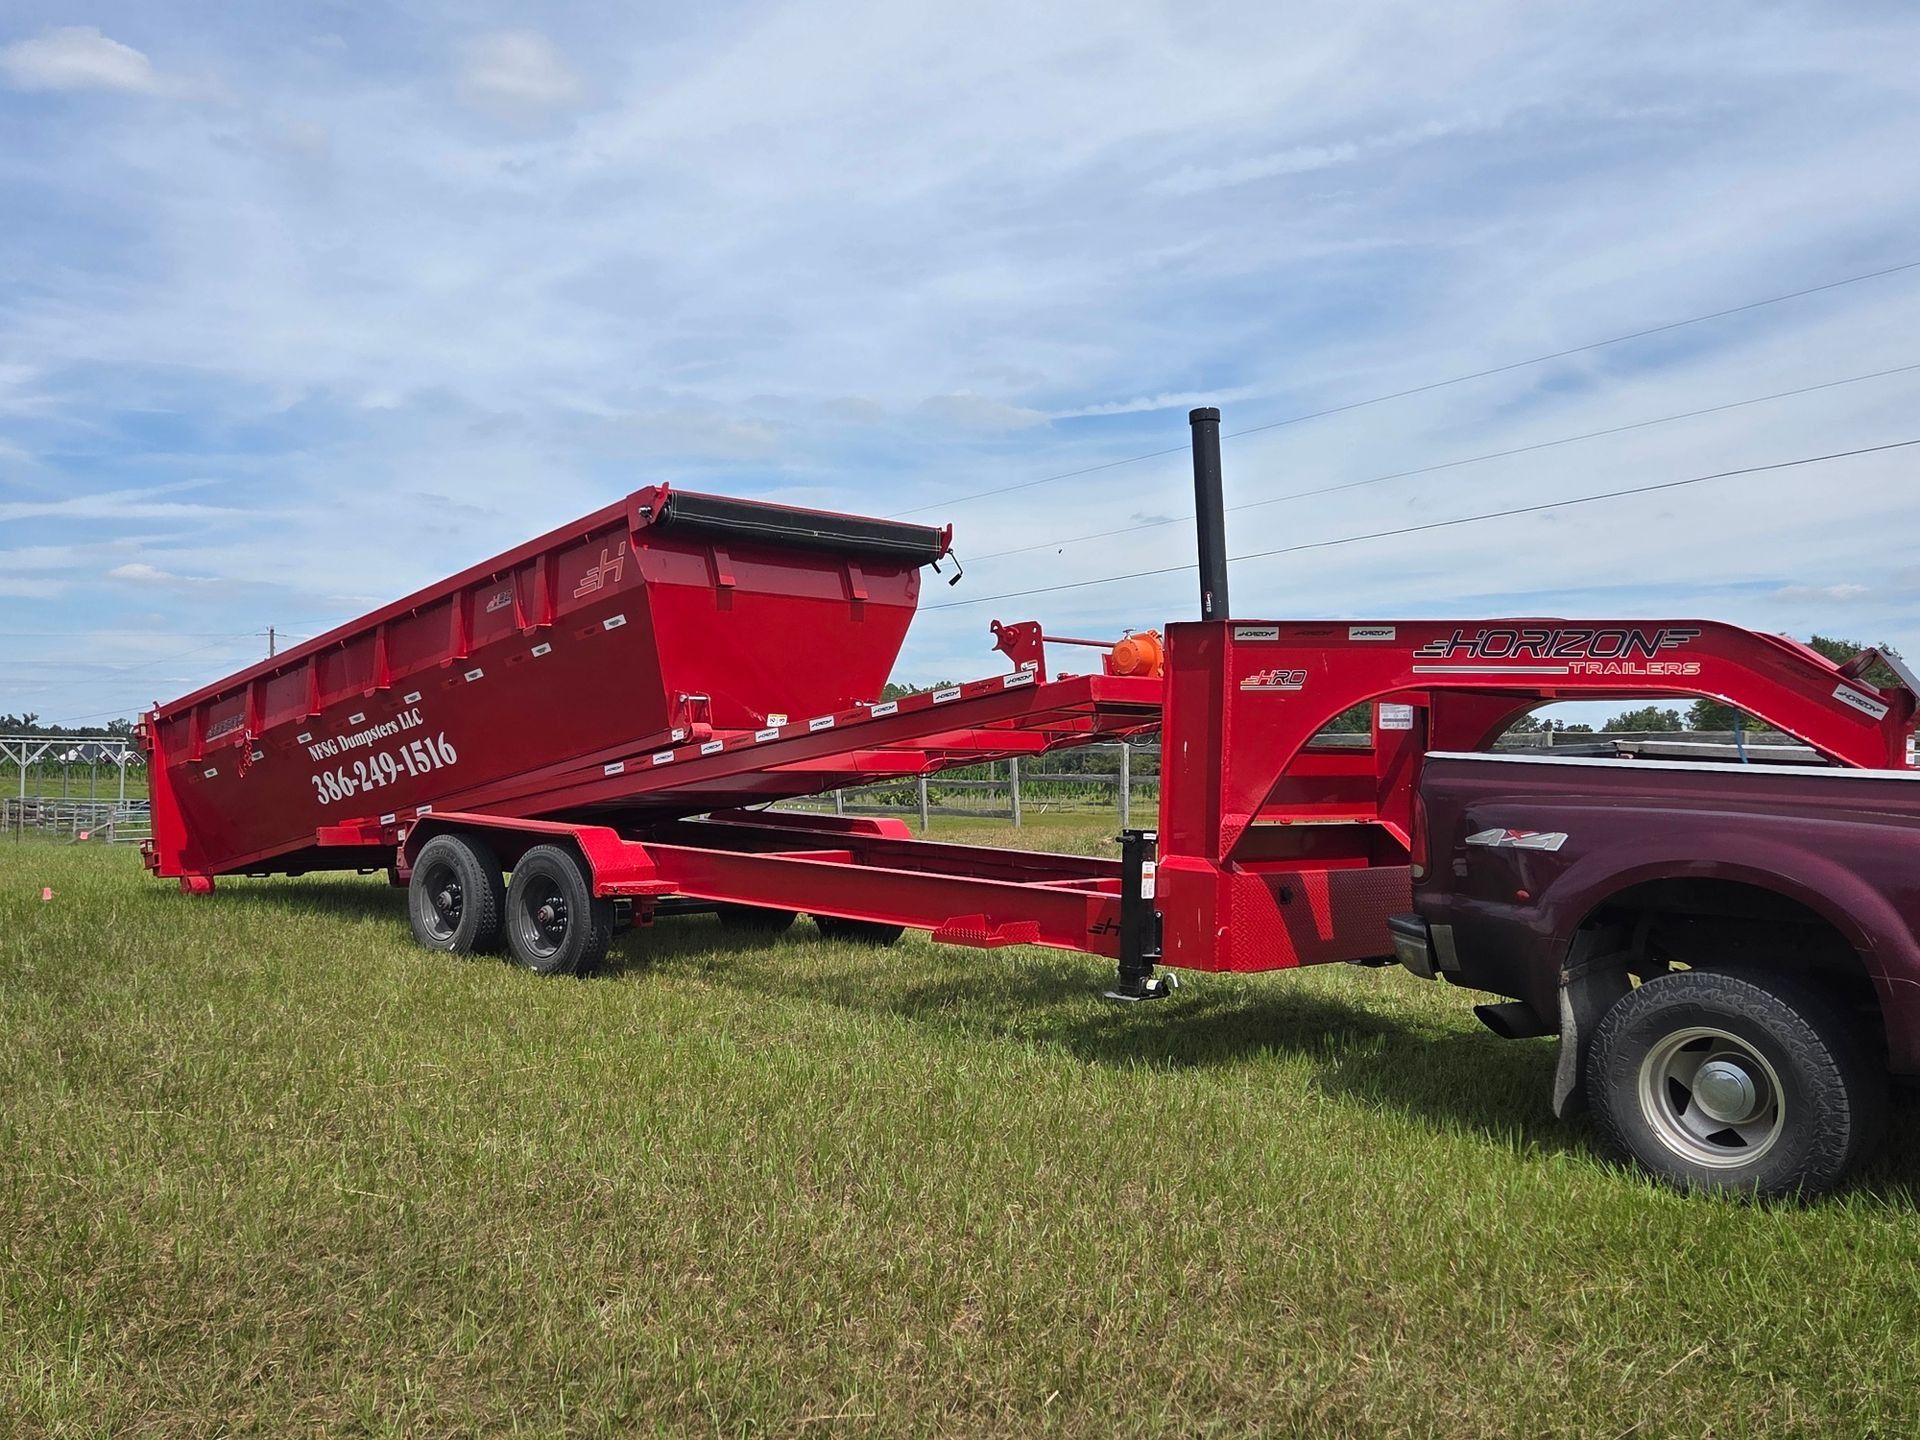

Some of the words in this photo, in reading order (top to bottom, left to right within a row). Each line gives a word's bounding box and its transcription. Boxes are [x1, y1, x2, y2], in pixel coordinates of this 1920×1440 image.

[1444, 629, 1667, 658] HORIZON
[1257, 670, 1307, 685] HRD
[1569, 661, 1701, 675] TRAILERS
[1843, 692, 1878, 712] HORIZON
[308, 738, 338, 762] NFSG
[337, 720, 399, 752] Dumpsters
[396, 707, 423, 730] LLC
[311, 731, 457, 805] 386-249-1516
